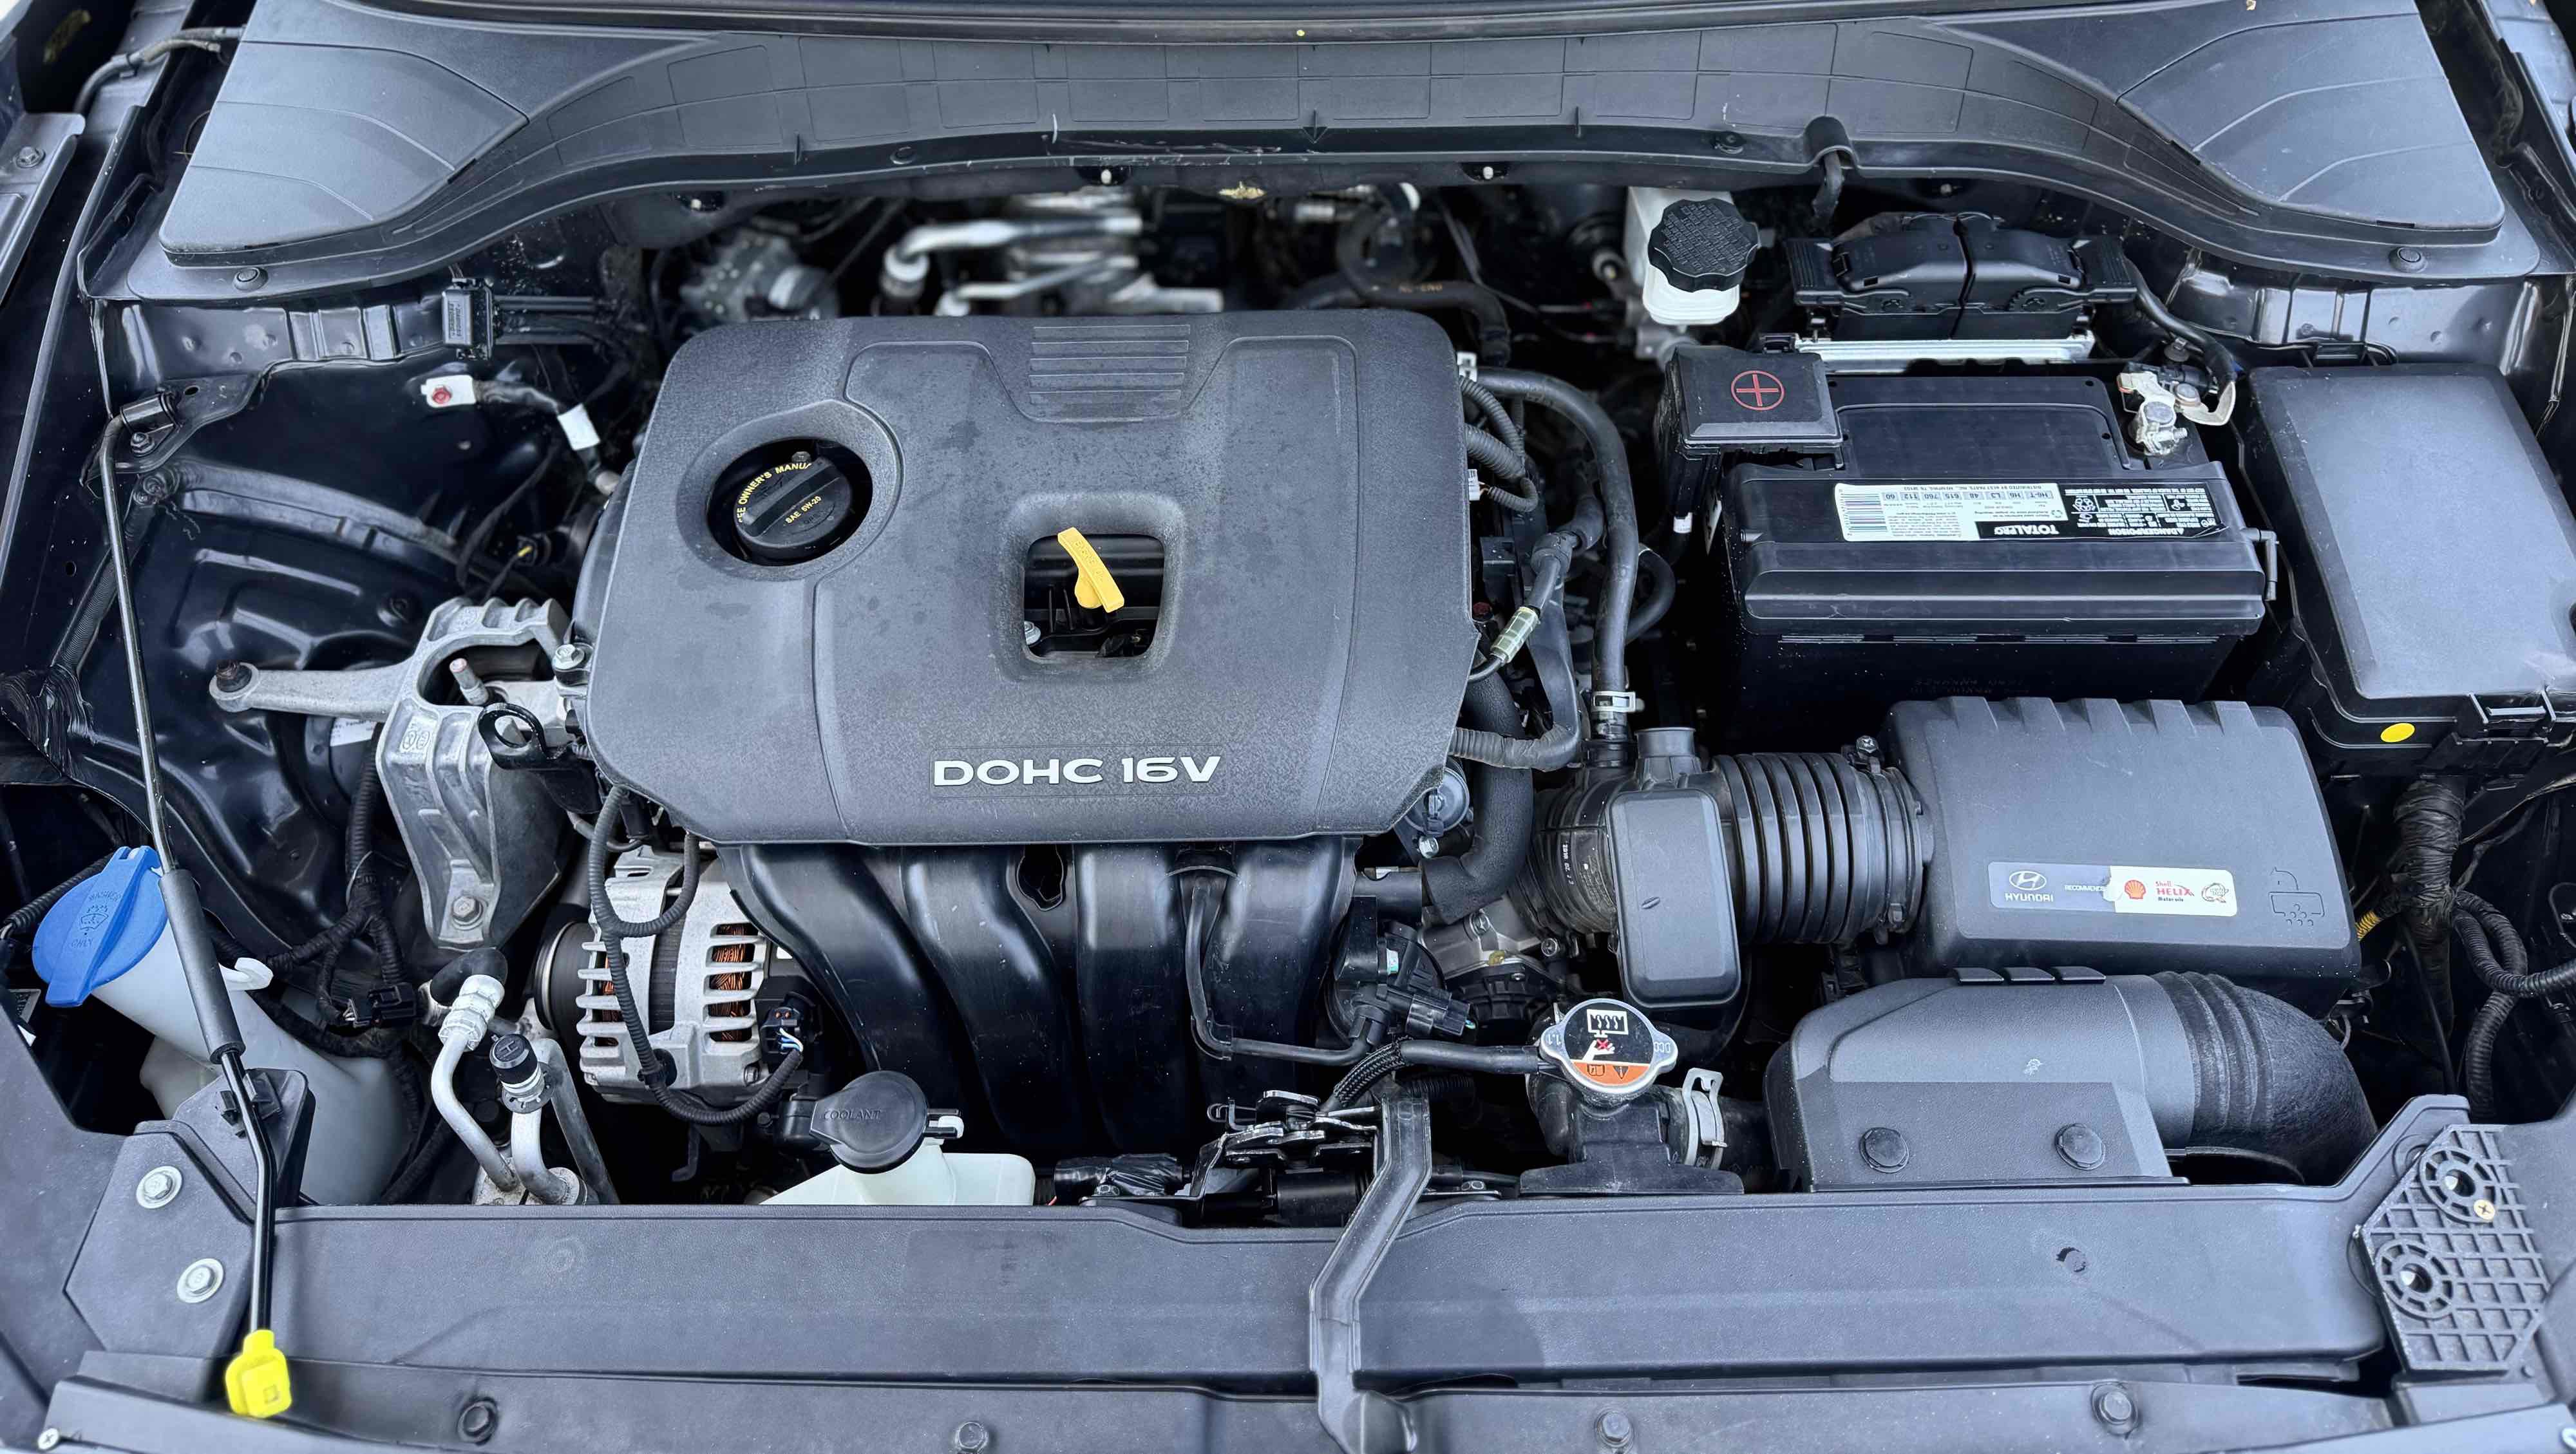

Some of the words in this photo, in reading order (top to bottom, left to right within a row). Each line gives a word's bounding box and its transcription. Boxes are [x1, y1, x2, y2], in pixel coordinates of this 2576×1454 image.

[738, 471, 772, 505] OWNER'S
[786, 511, 802, 524] SAE
[933, 757, 1103, 786] DOHC
[1122, 755, 1222, 784] 16V
[2005, 892, 2054, 902] HYUNDAI
[2157, 887, 2192, 896] HELIX
[824, 1108, 882, 1122] COOLANT
